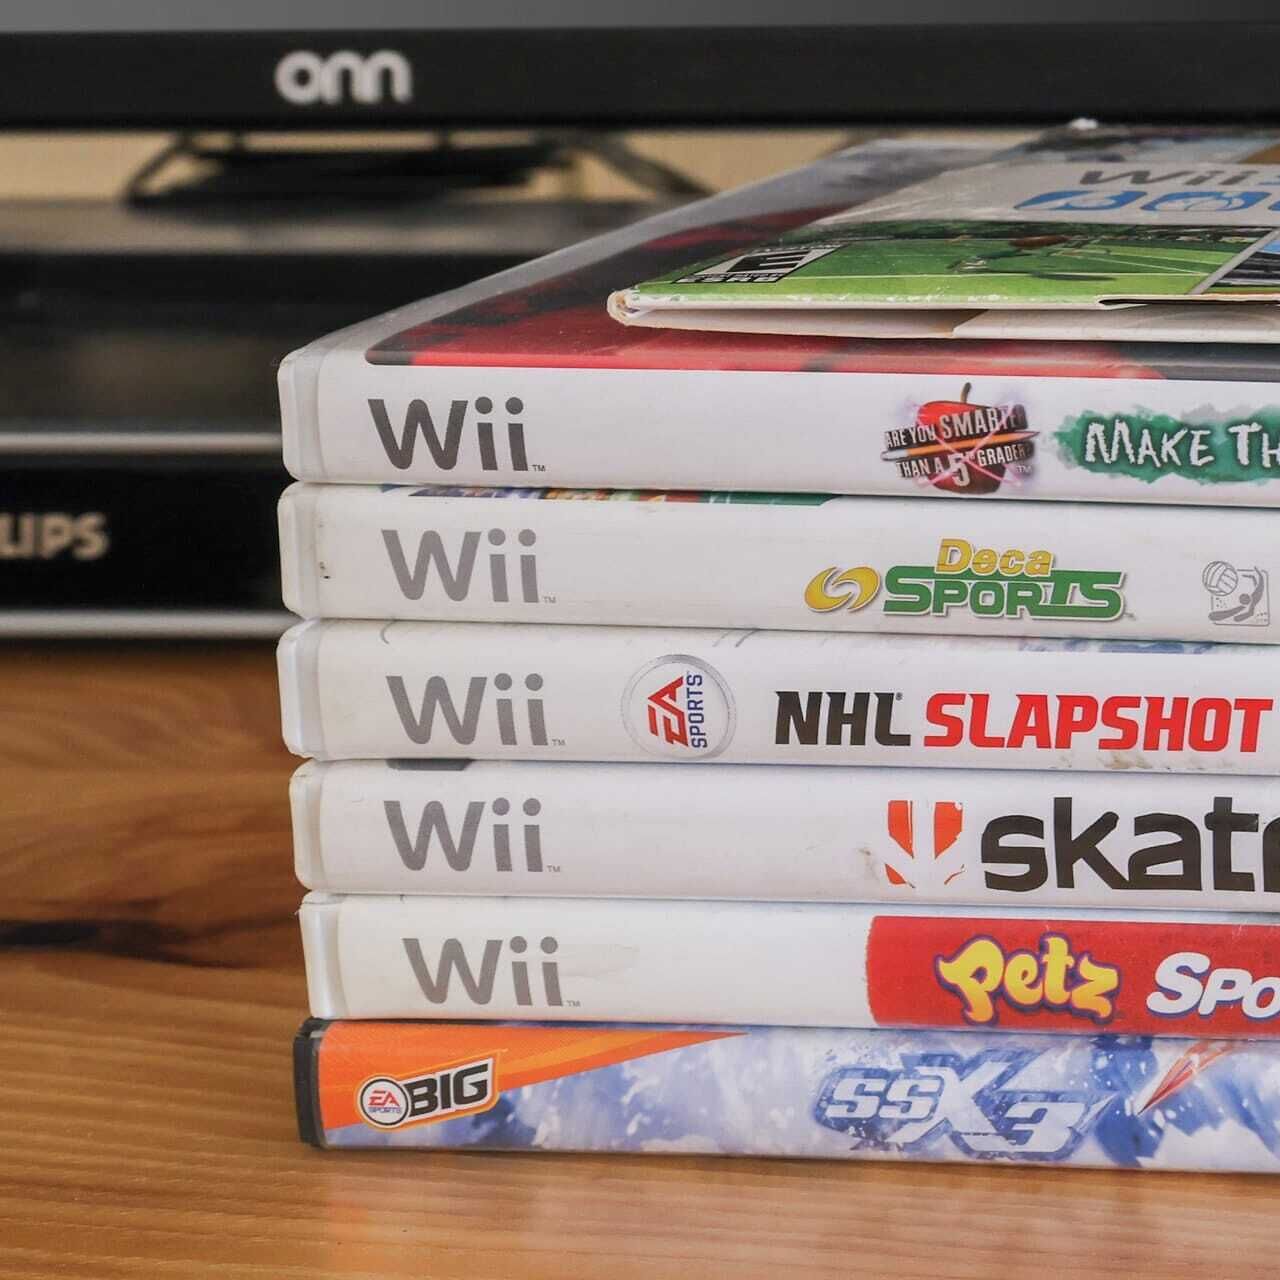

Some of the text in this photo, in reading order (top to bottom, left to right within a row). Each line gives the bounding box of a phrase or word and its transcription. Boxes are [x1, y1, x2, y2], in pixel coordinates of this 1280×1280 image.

[1080, 170, 1260, 187] Wii
[368, 397, 530, 472] Wii
[1084, 420, 1215, 467] MAKE
[896, 459, 930, 478] THAN
[381, 528, 542, 605] Wii
[935, 538, 1053, 576] Deca
[883, 565, 1123, 619] SPORTS
[385, 673, 551, 747] Wii
[647, 676, 689, 747] EA
[686, 674, 708, 748] SPORTS
[776, 691, 1274, 753] NHL SLAPSHOT
[384, 798, 545, 873] Wii
[403, 936, 566, 1008] Wii
[368, 1090, 401, 1106] EA
[402, 1062, 489, 1118] BIG
[823, 1060, 1012, 1145] SSX
